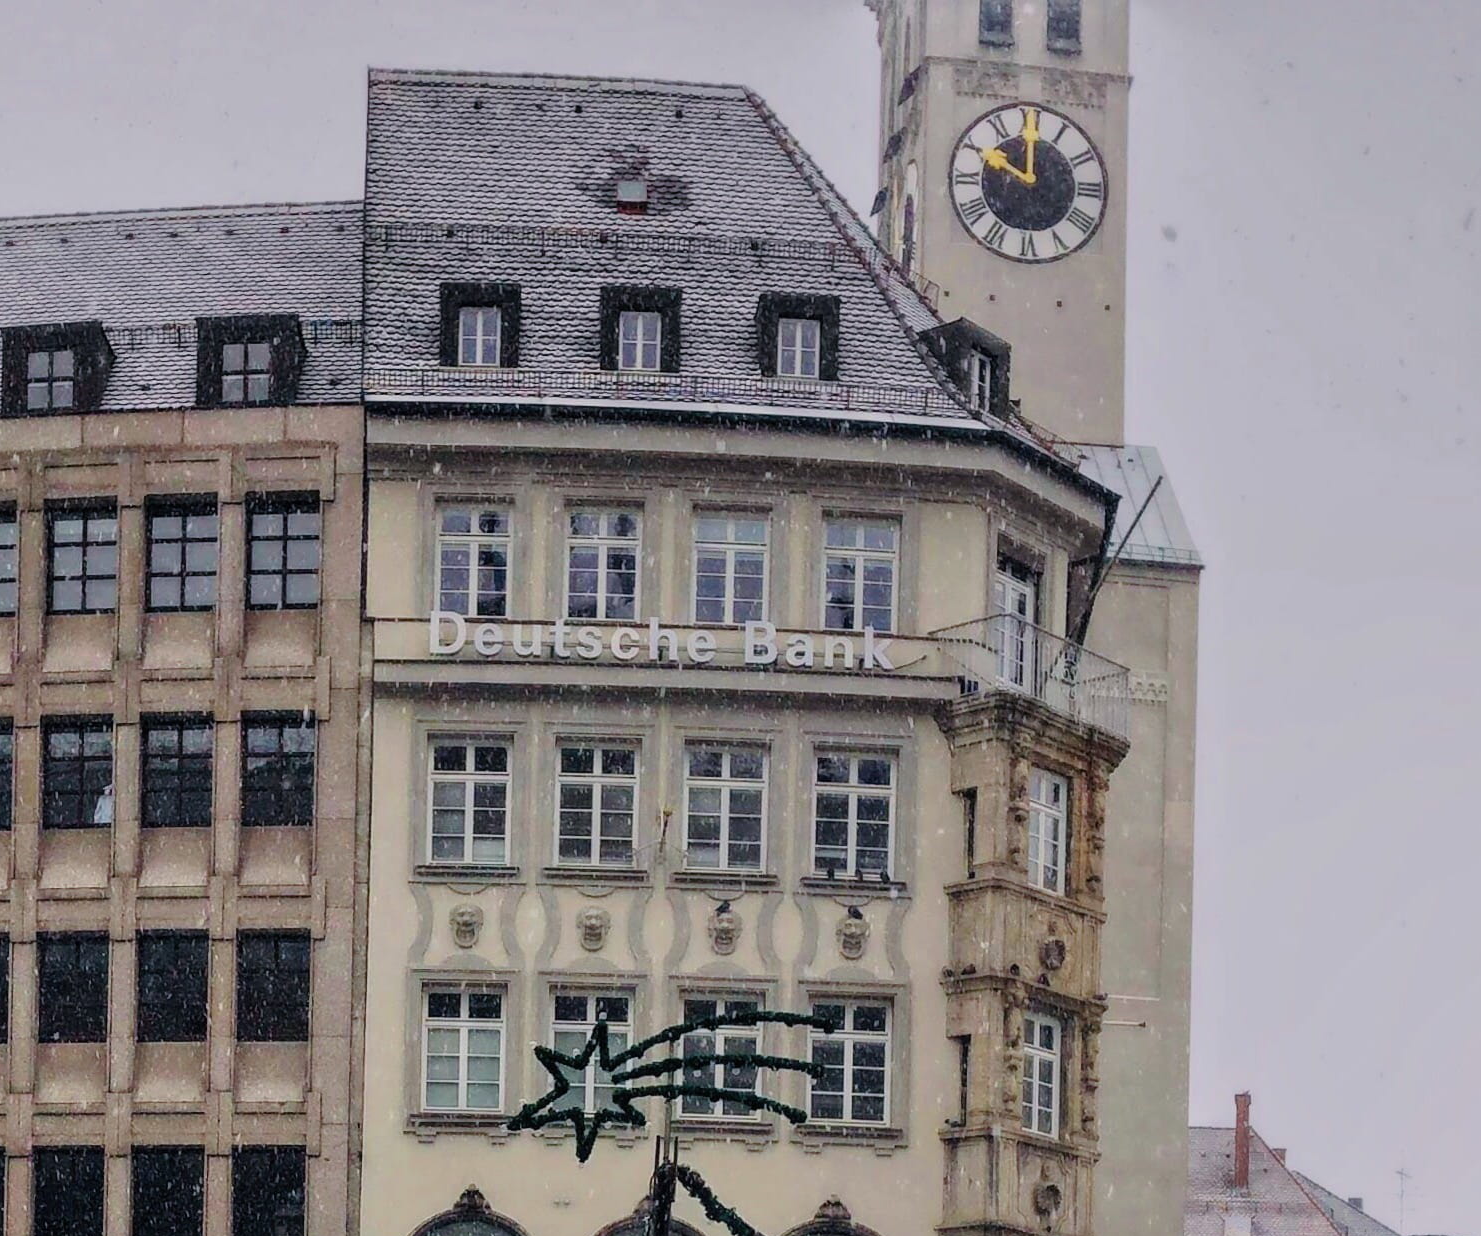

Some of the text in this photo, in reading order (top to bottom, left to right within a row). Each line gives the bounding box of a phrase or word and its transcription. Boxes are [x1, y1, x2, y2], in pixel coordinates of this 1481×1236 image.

[987, 114, 1011, 142] XI
[1070, 147, 1096, 169] II
[1077, 181, 1102, 200] III
[960, 197, 989, 227] VIII
[1066, 207, 1096, 234] IIII
[982, 220, 1008, 249] VII
[1019, 232, 1039, 257] VI
[1052, 229, 1070, 252] V
[428, 610, 896, 672] Deutsche Bank
